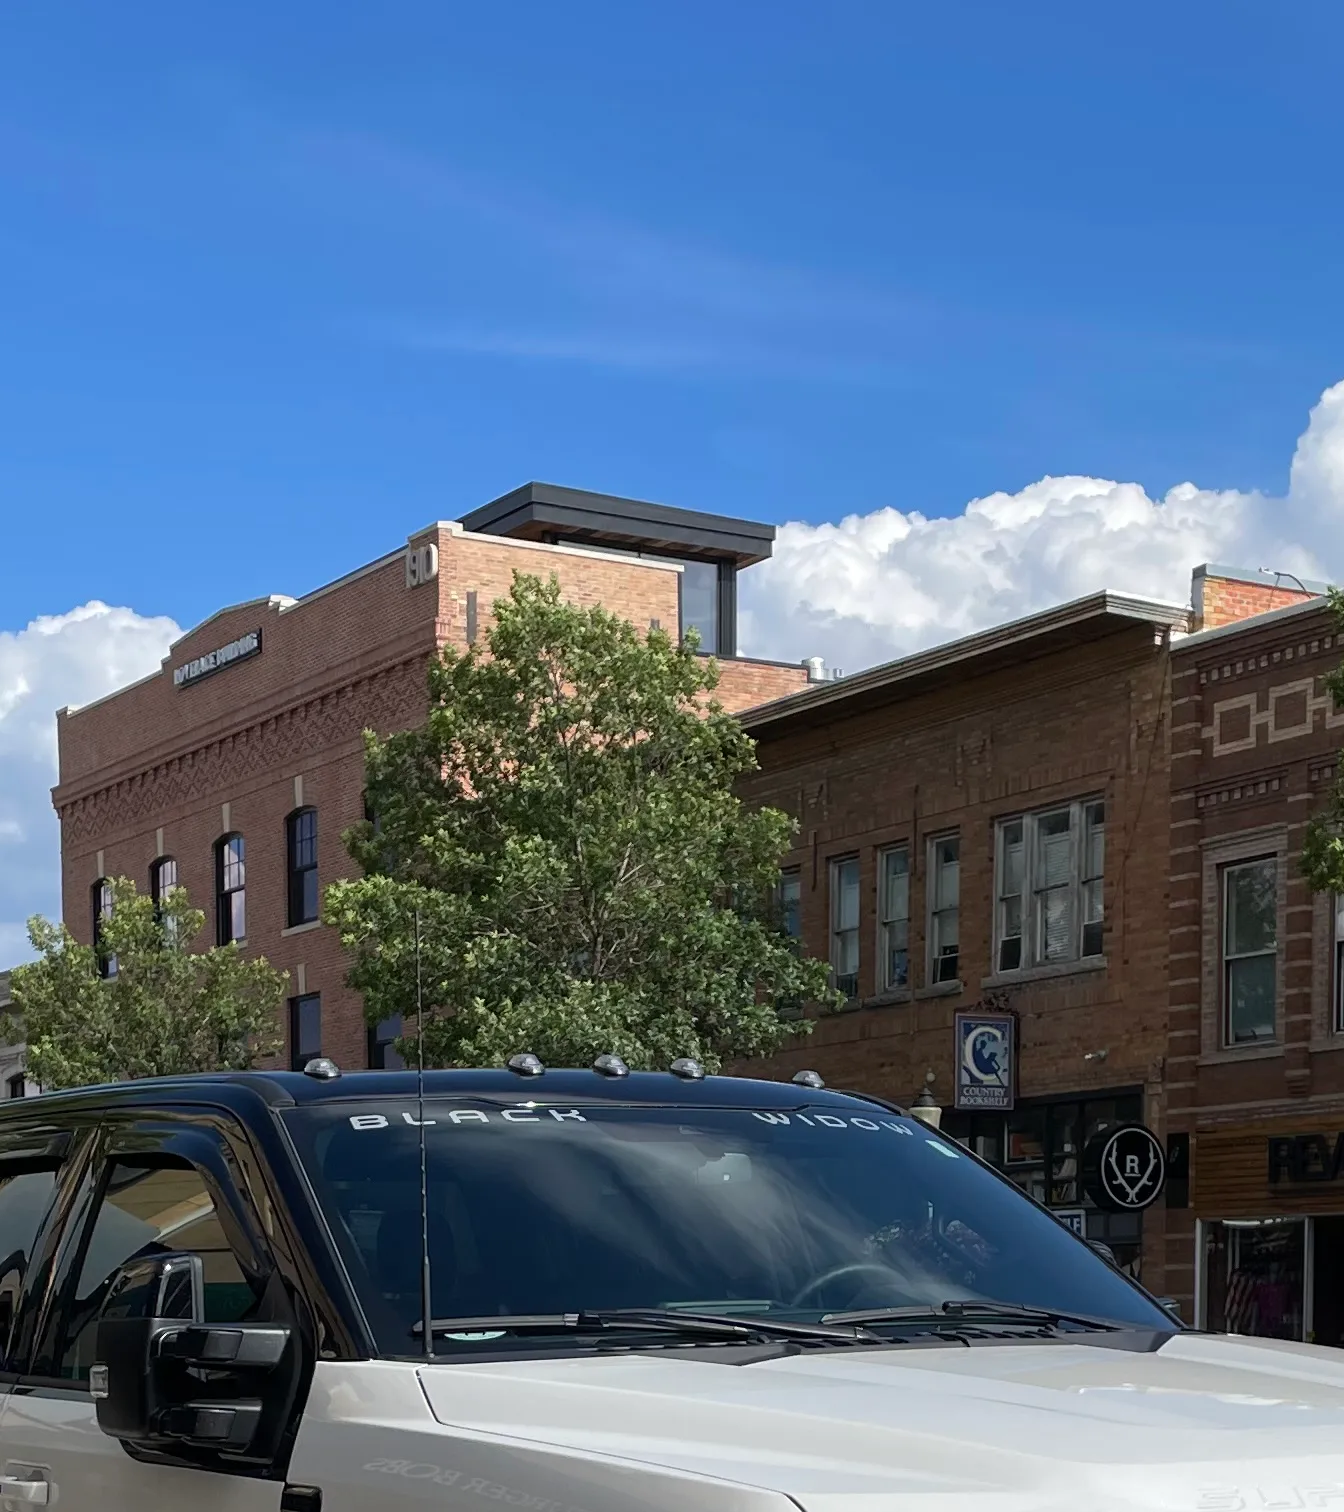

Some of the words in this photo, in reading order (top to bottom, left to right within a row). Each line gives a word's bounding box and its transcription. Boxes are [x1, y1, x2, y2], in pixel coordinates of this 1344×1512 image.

[406, 543, 439, 588] 1910
[959, 1097, 1009, 1106] BOOKSHELF
[962, 1086, 1006, 1097] COUNTRY
[349, 1109, 587, 1131] BLACK
[751, 1112, 914, 1136] WIDOW
[1126, 1154, 1140, 1174] R
